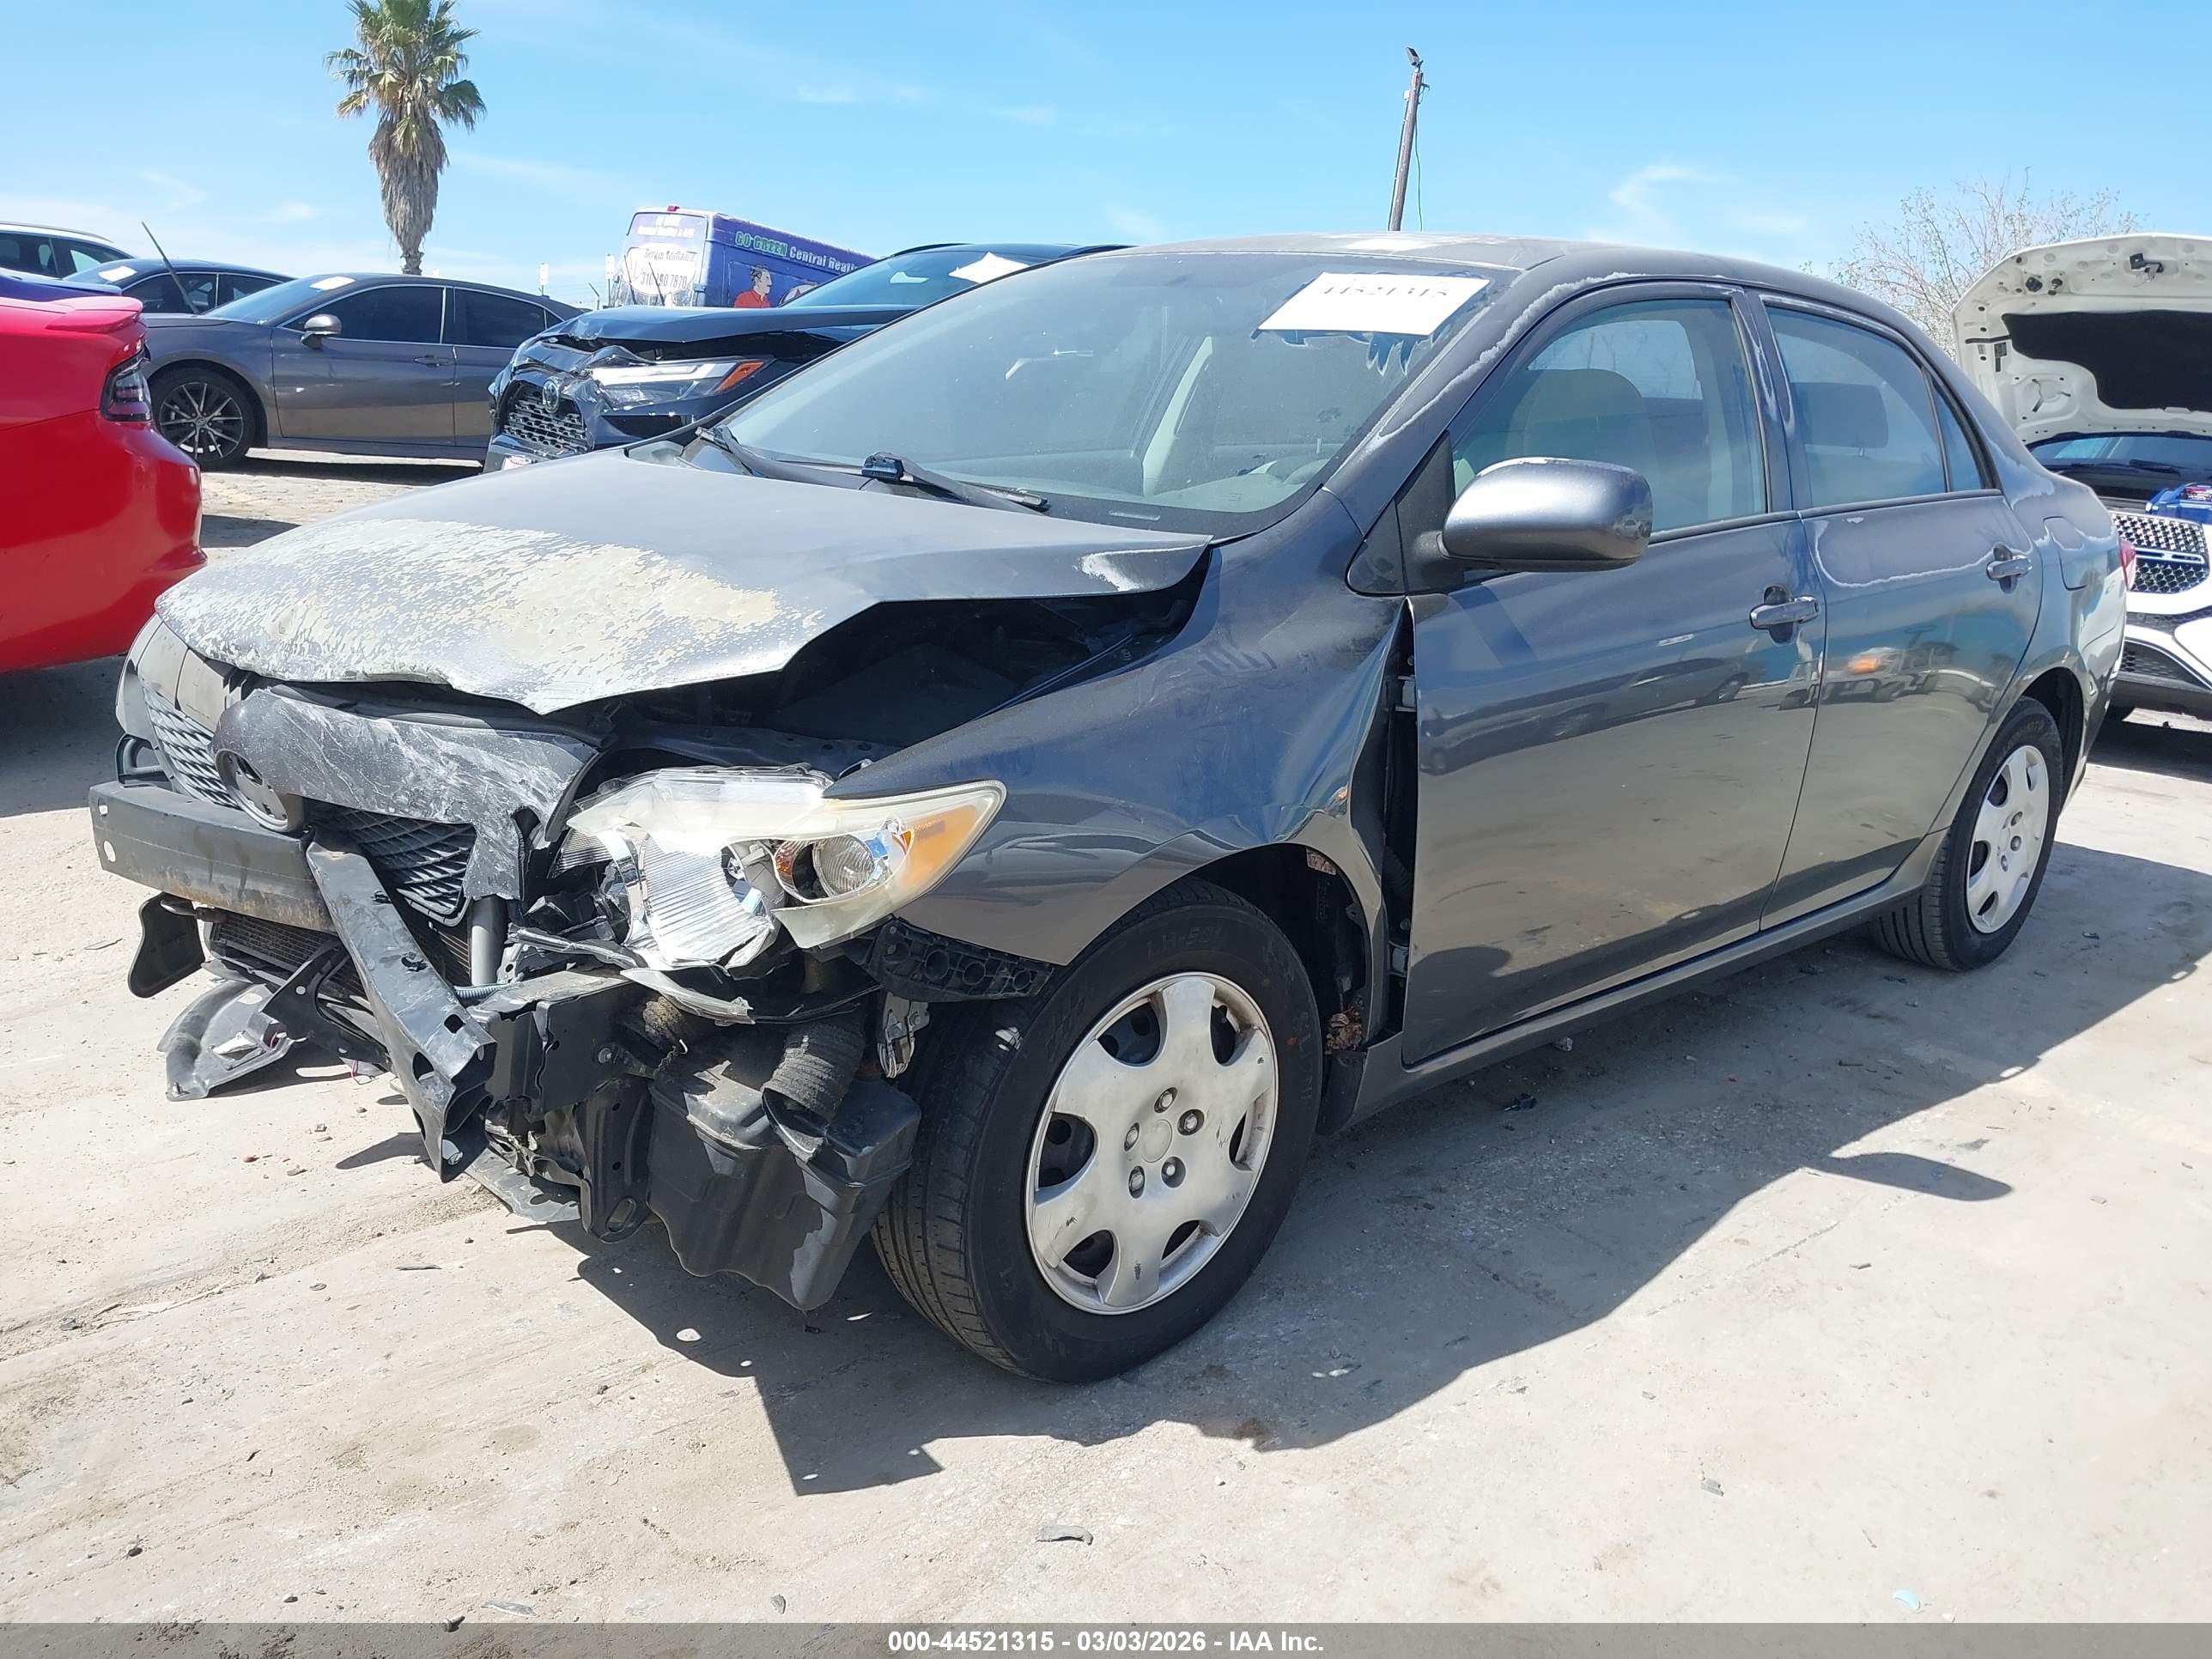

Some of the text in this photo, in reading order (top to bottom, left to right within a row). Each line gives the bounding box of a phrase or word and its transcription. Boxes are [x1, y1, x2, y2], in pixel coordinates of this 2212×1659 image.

[753, 235, 788, 257] GREEN
[789, 246, 827, 266] Central
[670, 274, 688, 289] 7870
